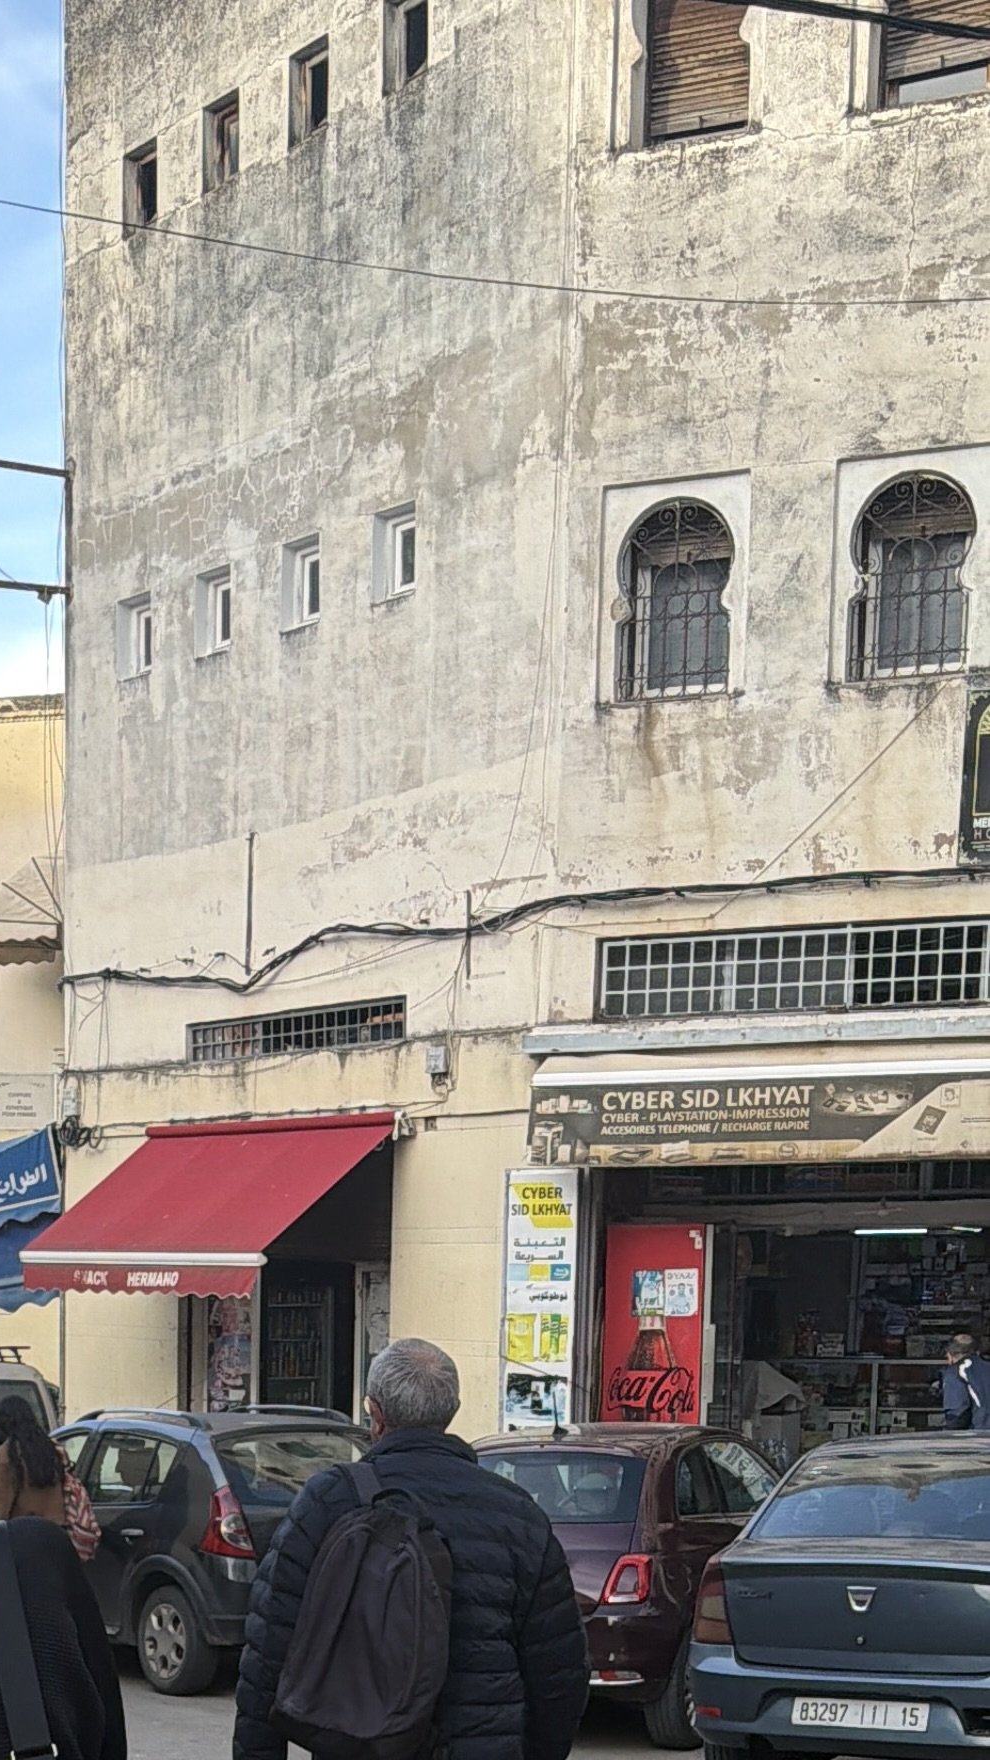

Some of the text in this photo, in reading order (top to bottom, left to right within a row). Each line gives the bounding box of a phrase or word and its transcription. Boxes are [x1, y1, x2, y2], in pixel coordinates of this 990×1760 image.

[602, 1085, 815, 1111] CYBER SID LKHYAT
[601, 1112, 640, 1124] CYBER
[658, 1122, 711, 1135] TELEPHONE
[721, 1121, 773, 1133] RECHARGE
[774, 1120, 810, 1131] RAPIDE
[522, 1187, 563, 1200] CYBER
[511, 1203, 573, 1216] SID LKHYAT
[126, 1271, 179, 1287] HERMANO
[799, 1702, 849, 1722] 83297
[901, 1707, 920, 1726] 15
